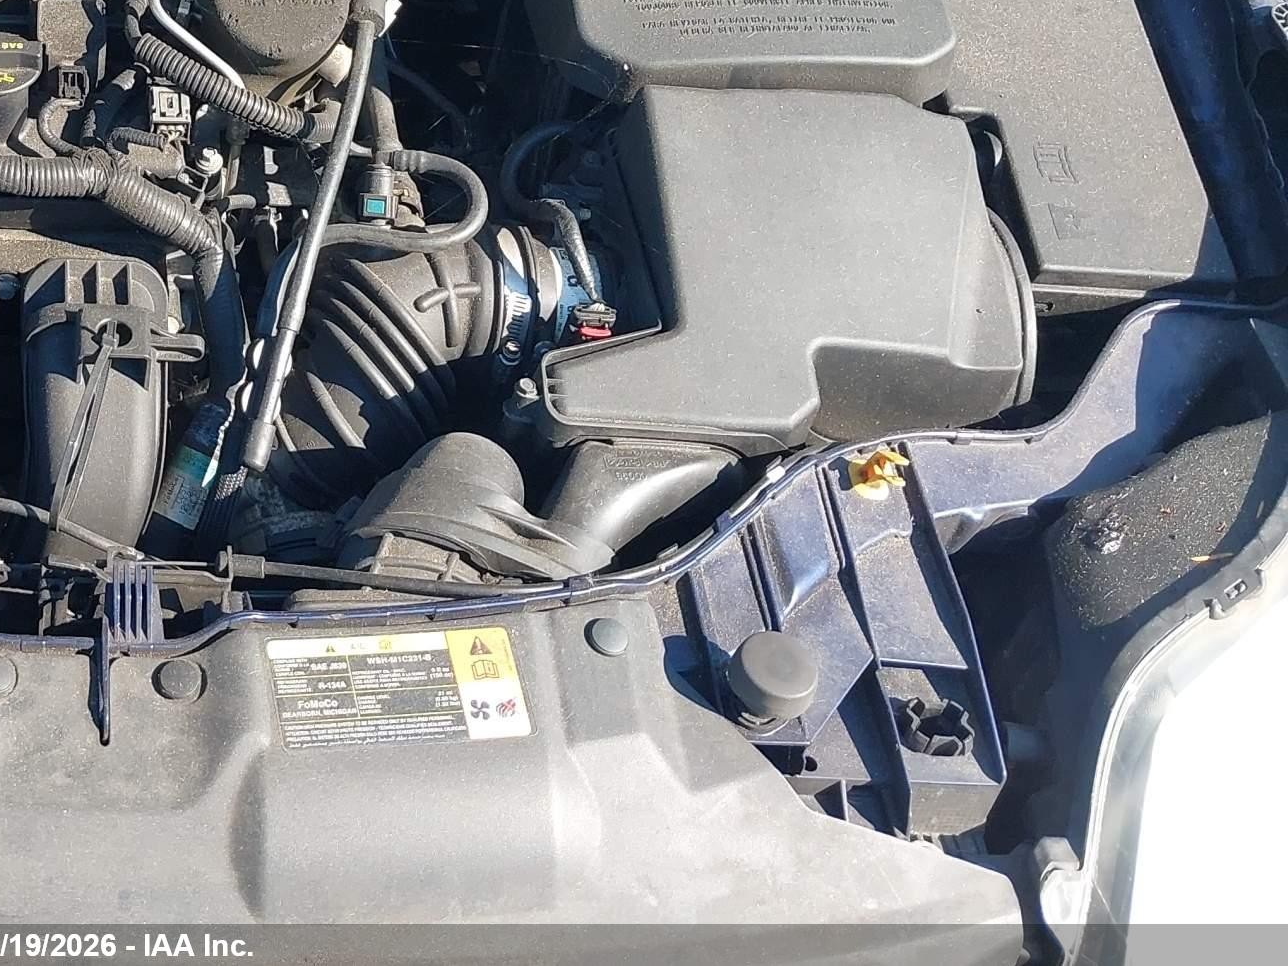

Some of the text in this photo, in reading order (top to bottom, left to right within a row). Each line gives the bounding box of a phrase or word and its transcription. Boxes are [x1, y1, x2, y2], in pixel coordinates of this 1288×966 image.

[1, 42, 24, 50] SAE
[310, 662, 328, 670] SAE
[317, 681, 347, 690] R-134A
[297, 699, 339, 709] FoMoCo
